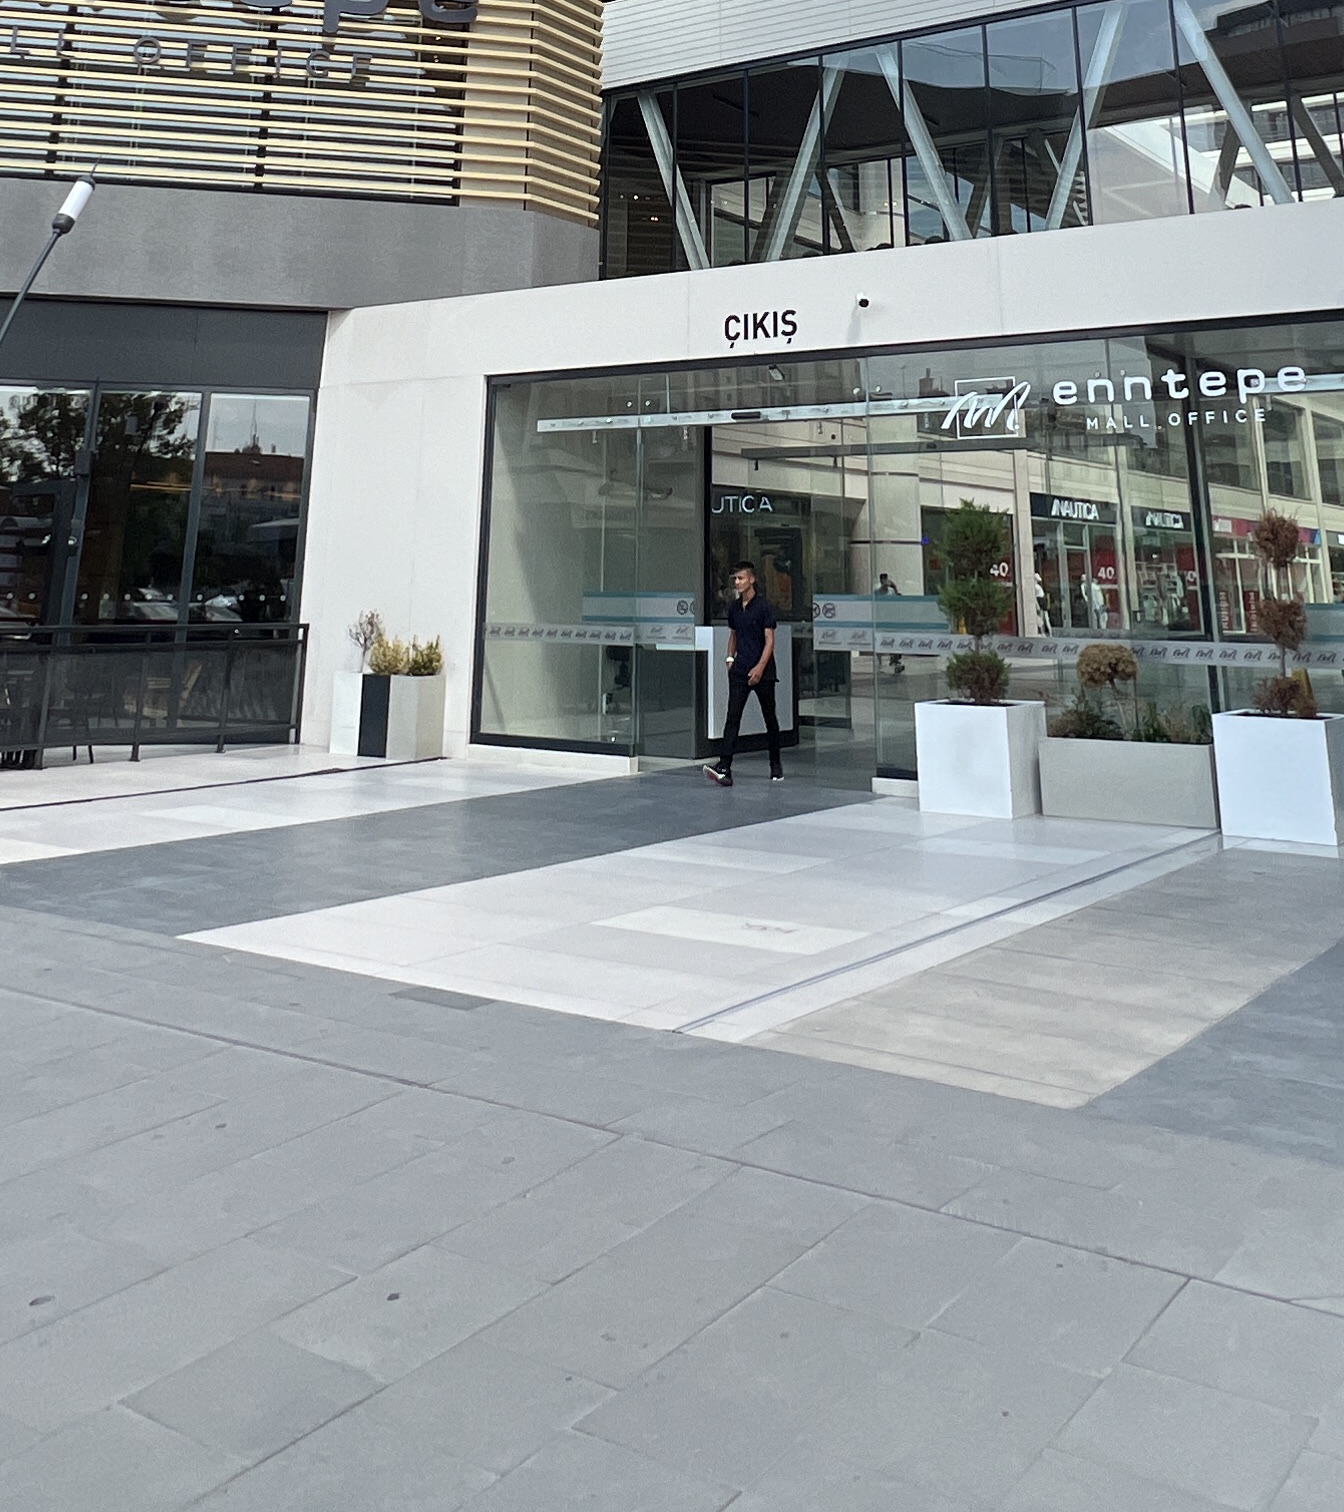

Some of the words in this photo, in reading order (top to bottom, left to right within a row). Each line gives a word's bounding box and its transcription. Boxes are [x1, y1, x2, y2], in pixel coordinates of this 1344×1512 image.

[132, 35, 375, 86] OFFICE
[723, 308, 799, 350] ÇIKIŞ
[1086, 414, 1151, 432] MALL
[1167, 407, 1267, 427] OFFICE
[1054, 499, 1100, 521] NAUTICA
[1097, 566, 1115, 580] 40
